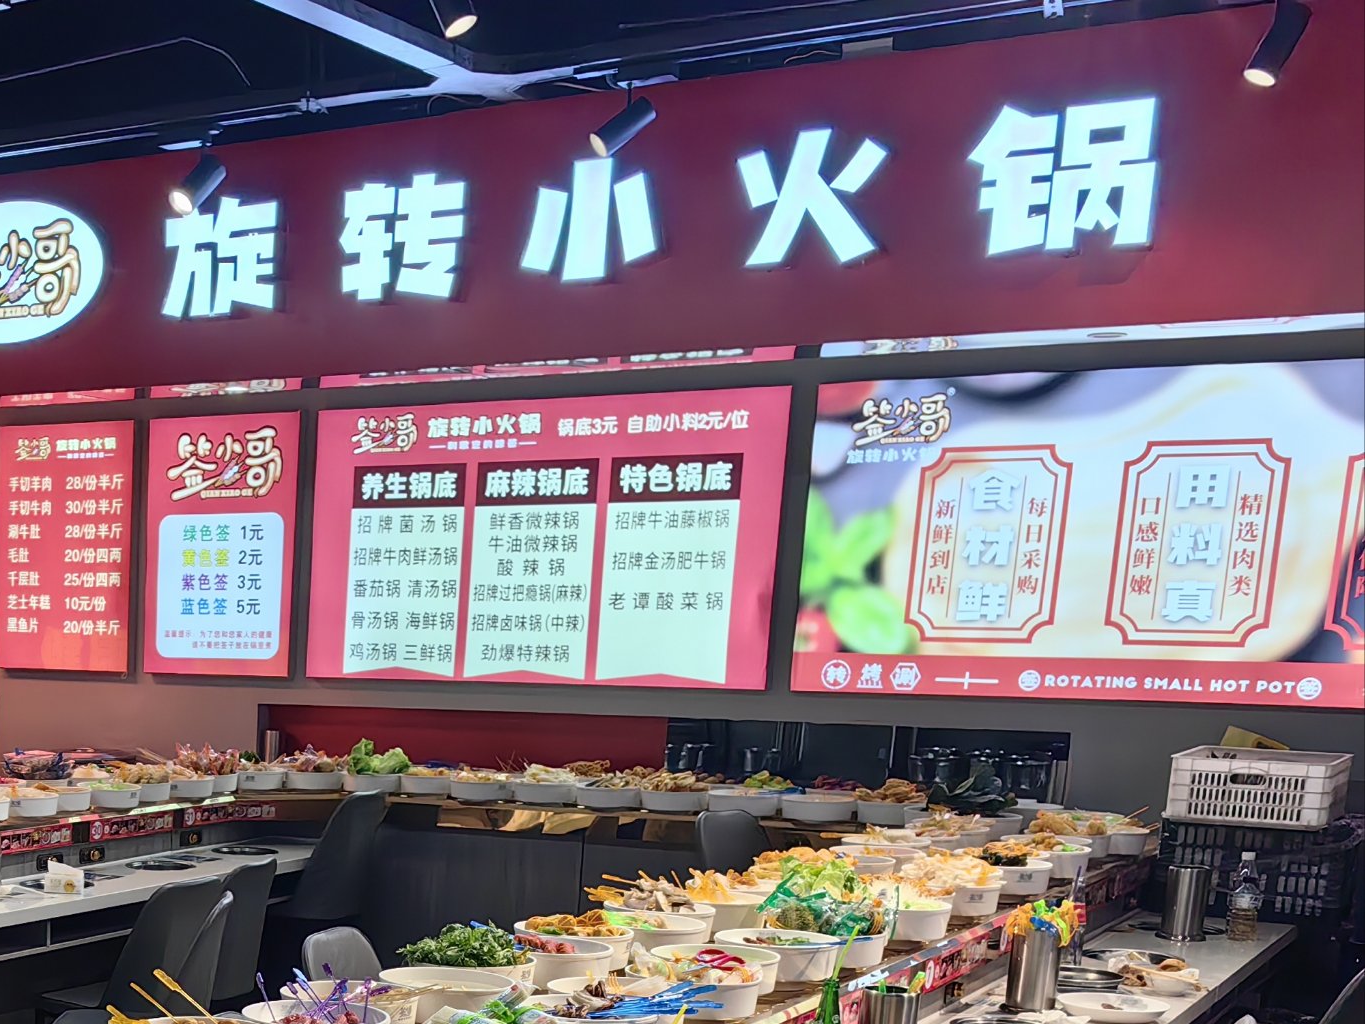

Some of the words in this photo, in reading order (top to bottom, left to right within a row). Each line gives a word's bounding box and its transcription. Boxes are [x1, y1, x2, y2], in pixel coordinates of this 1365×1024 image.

[161, 96, 1158, 321] 旋转小火锅
[427, 413, 542, 438] 旋转小火锅
[557, 416, 618, 437] 锅底3元
[627, 410, 749, 434] 自助小料2元/位
[851, 393, 951, 447] 签小哥
[167, 426, 283, 502] 签小哥
[9, 476, 52, 493] 手切羊肉
[66, 474, 124, 491] 28/份半斤
[361, 470, 458, 501] 养生锅底
[484, 467, 590, 498] 麻辣锅底
[619, 461, 734, 494] 特色锅底
[9, 500, 52, 516] 手切牛肉
[65, 499, 124, 515] 30/份半斤
[357, 514, 458, 534] 招牌菌汤锅
[489, 511, 580, 530] 鲜香微辣锅
[615, 509, 730, 530] 招牌牛油藤椒锅
[8, 524, 41, 539] 涮牛肚
[65, 523, 123, 539] 28/份半斤
[183, 524, 230, 542] 绿色签
[240, 524, 264, 541] 1元
[488, 534, 578, 553] 牛油微辣锅
[926, 498, 956, 596] 新鲜到店
[956, 469, 1021, 622] 食材鲜
[1016, 497, 1048, 595] 每日采购
[1129, 496, 1162, 596] 口感鲜嫩
[1161, 464, 1232, 624] 用料真
[1228, 493, 1263, 597] 精选肉类
[8, 548, 29, 563] 毛肚
[64, 548, 122, 563] 20/份四两
[181, 548, 230, 567] 黄色签
[238, 549, 263, 565] 2元
[353, 547, 458, 566] 招牌牛肉鲜汤锅
[612, 551, 726, 571] 招牌金汤肥牛锅
[496, 558, 565, 576] 酸辣锅
[7, 571, 40, 586] 千层肚
[63, 572, 122, 587] 25/份四两
[181, 573, 229, 591] 紫色签
[237, 574, 262, 590] 3元
[353, 580, 401, 598] 番茄锅
[407, 579, 457, 598] 清汤锅
[7, 594, 51, 610] 芝士年糕
[64, 596, 106, 611] 10元/份
[180, 598, 227, 615] 蓝色签
[236, 598, 261, 615] 5元
[7, 617, 39, 633] 黑鱼片
[63, 620, 120, 635] 20/份半斤
[351, 611, 399, 630] 骨汤锅
[405, 611, 455, 631] 海鲜锅
[349, 643, 397, 661] 鸡汤锅
[403, 644, 452, 662] 三鲜锅
[481, 644, 570, 662] 劲爆特辣锅
[1045, 674, 1138, 689] ROTATING
[1144, 677, 1203, 691] SMALL
[1210, 679, 1250, 693] HOT
[1256, 680, 1297, 694] POT
[91, 826, 103, 838] 30
